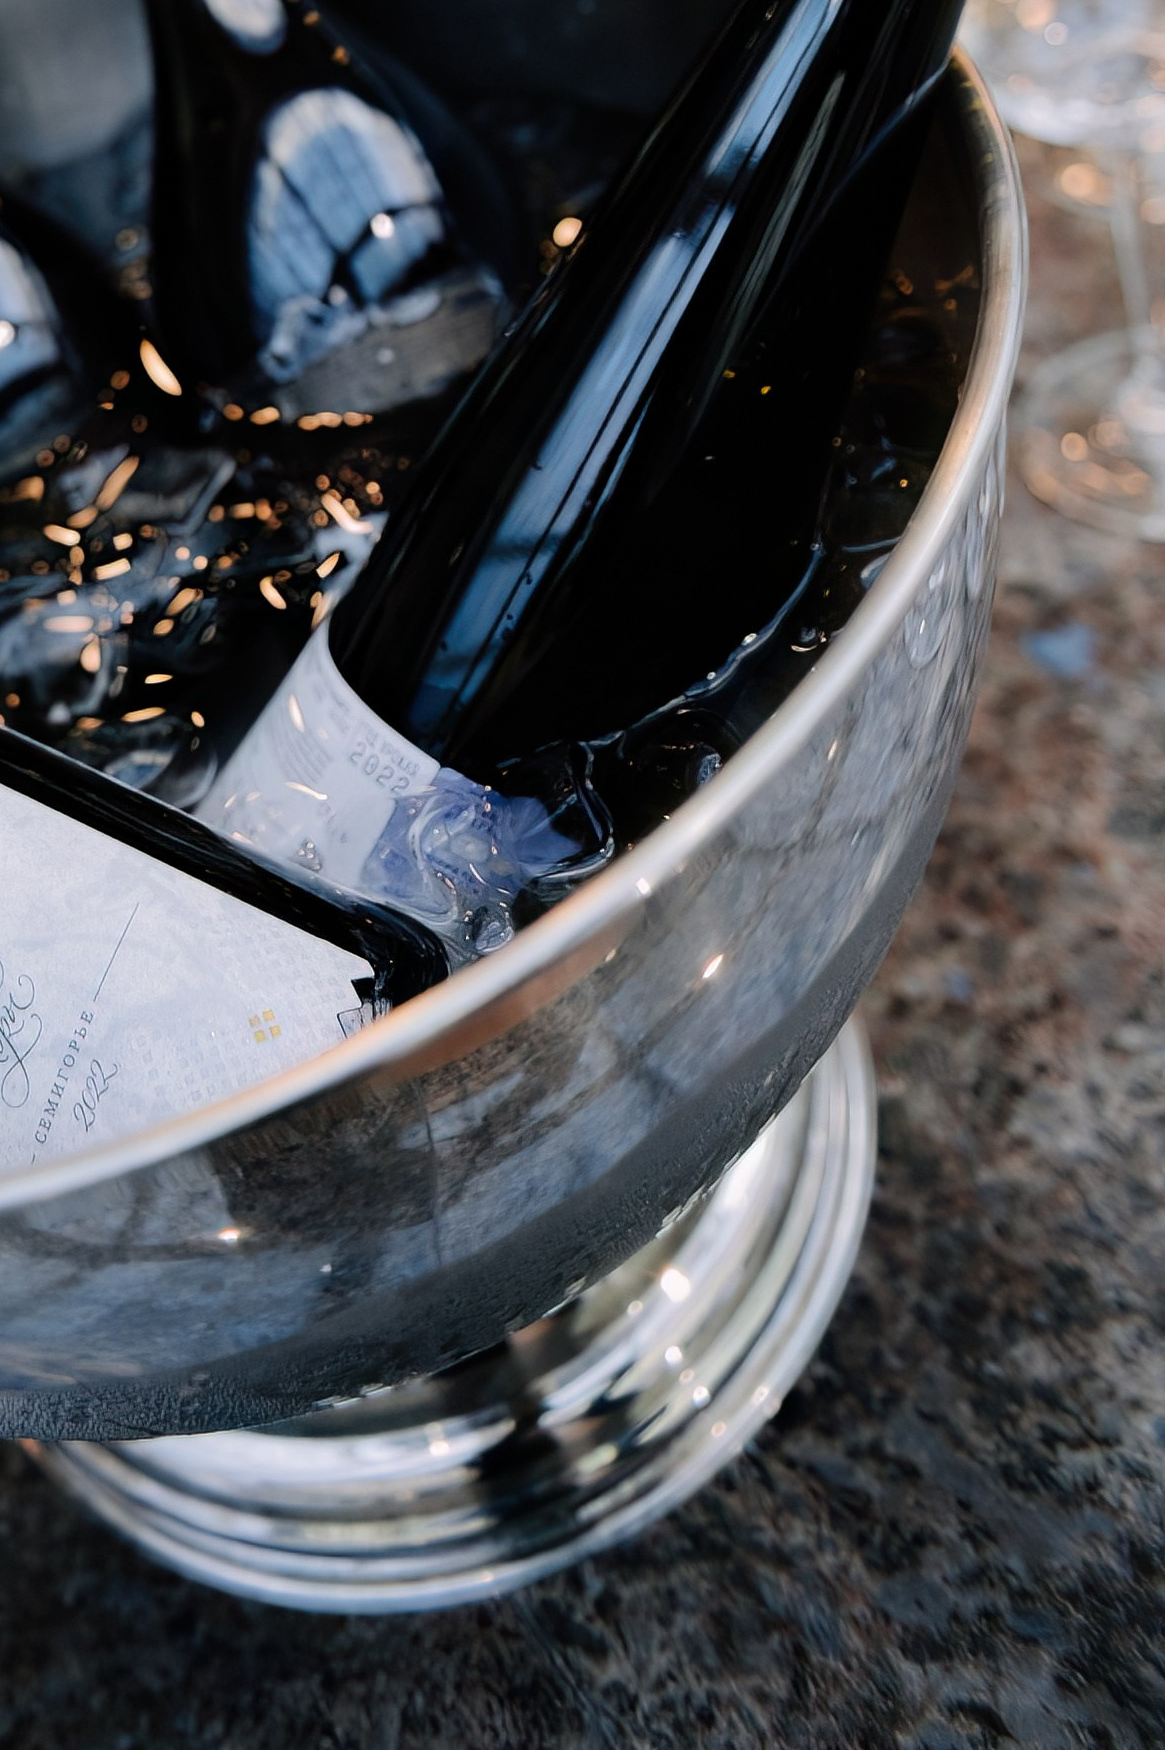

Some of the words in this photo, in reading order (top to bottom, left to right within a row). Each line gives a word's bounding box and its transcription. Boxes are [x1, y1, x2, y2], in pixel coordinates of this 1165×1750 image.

[350, 741, 409, 792] 2022
[35, 1010, 94, 1144] СЕМИГОРЬЕ
[73, 1059, 121, 1132] 2022
